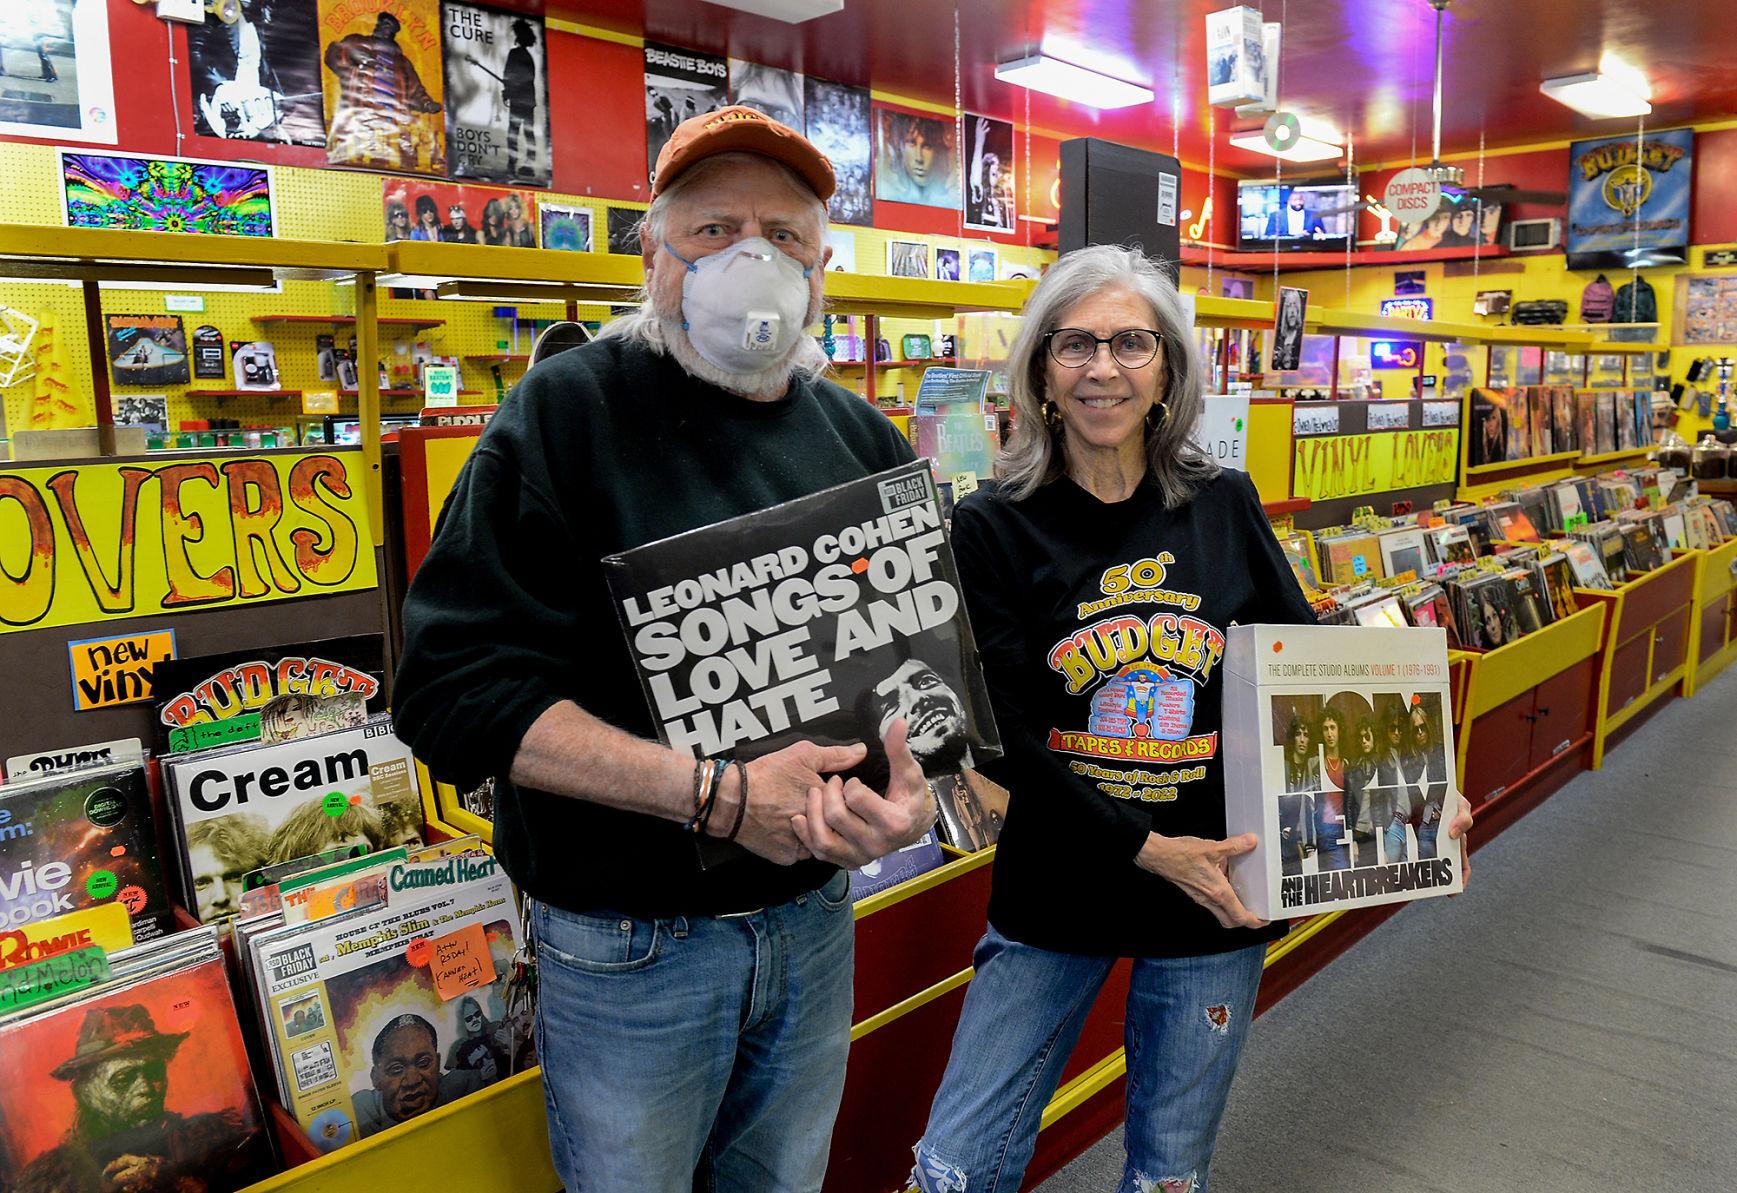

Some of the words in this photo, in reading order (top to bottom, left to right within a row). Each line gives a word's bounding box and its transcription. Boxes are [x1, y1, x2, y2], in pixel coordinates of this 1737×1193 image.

[449, 8, 482, 28] THE
[450, 25, 494, 45] CURE
[645, 48, 696, 71] BEASTIE
[697, 58, 727, 78] BOYS
[456, 128, 491, 142] BOYS
[457, 141, 500, 156] DON'T
[457, 153, 483, 166] CRY
[1389, 181, 1437, 196] COMPACT
[1397, 197, 1428, 211] DISCS
[1298, 436, 1375, 500] VINYL
[1390, 431, 1453, 489] LOVERS
[895, 477, 924, 494] BLACK
[895, 487, 925, 505] FRIDAY
[623, 545, 809, 626] LEONARD
[813, 501, 940, 564] COHEN
[635, 563, 861, 671] SONGS
[867, 530, 945, 593] OF
[1078, 589, 1201, 620] Anniversary
[88, 639, 148, 671] new
[648, 625, 819, 721] LOVE
[834, 580, 959, 662] AND
[1049, 613, 1226, 694] BUDGET
[79, 654, 170, 704] viny
[1268, 664, 1280, 676] THE
[1282, 663, 1317, 676] COMPLETE
[1318, 663, 1342, 676] STUDIO
[1344, 663, 1369, 676] ALBUMS
[1371, 663, 1395, 676] VOLUME
[162, 657, 379, 728] BUDGET
[664, 669, 840, 757] HATE
[1063, 735, 1122, 753] TAPES
[1137, 738, 1211, 759] RECORDS
[1271, 691, 1448, 793] TOM
[189, 749, 369, 812] Cream
[371, 762, 406, 776] Cream
[1069, 760, 1088, 775] 50
[1087, 764, 1122, 780] Years
[1124, 770, 1140, 785] of
[1139, 770, 1169, 785] Rock
[1180, 766, 1206, 781] Roll
[1098, 783, 1132, 799] 1972
[1140, 786, 1178, 802] 2022
[1278, 783, 1448, 876] PETTY
[390, 860, 456, 892] Canned
[456, 855, 498, 883] Heat
[1282, 875, 1303, 894] AND
[1305, 858, 1453, 905] HEARTBREAKERS
[1282, 891, 1303, 909] THE
[335, 926, 367, 941] HOUSE
[381, 915, 401, 927] THE
[402, 906, 431, 920] BLUES
[335, 928, 398, 957] Memphis
[398, 918, 431, 936] Slim
[454, 906, 486, 919] Memphis
[281, 947, 312, 965] BLACK
[365, 939, 409, 958] MEMPHIS
[281, 958, 313, 977] FRIDAY
[272, 971, 320, 993] EXCLUSIVE
[173, 1001, 191, 1010] NEW
